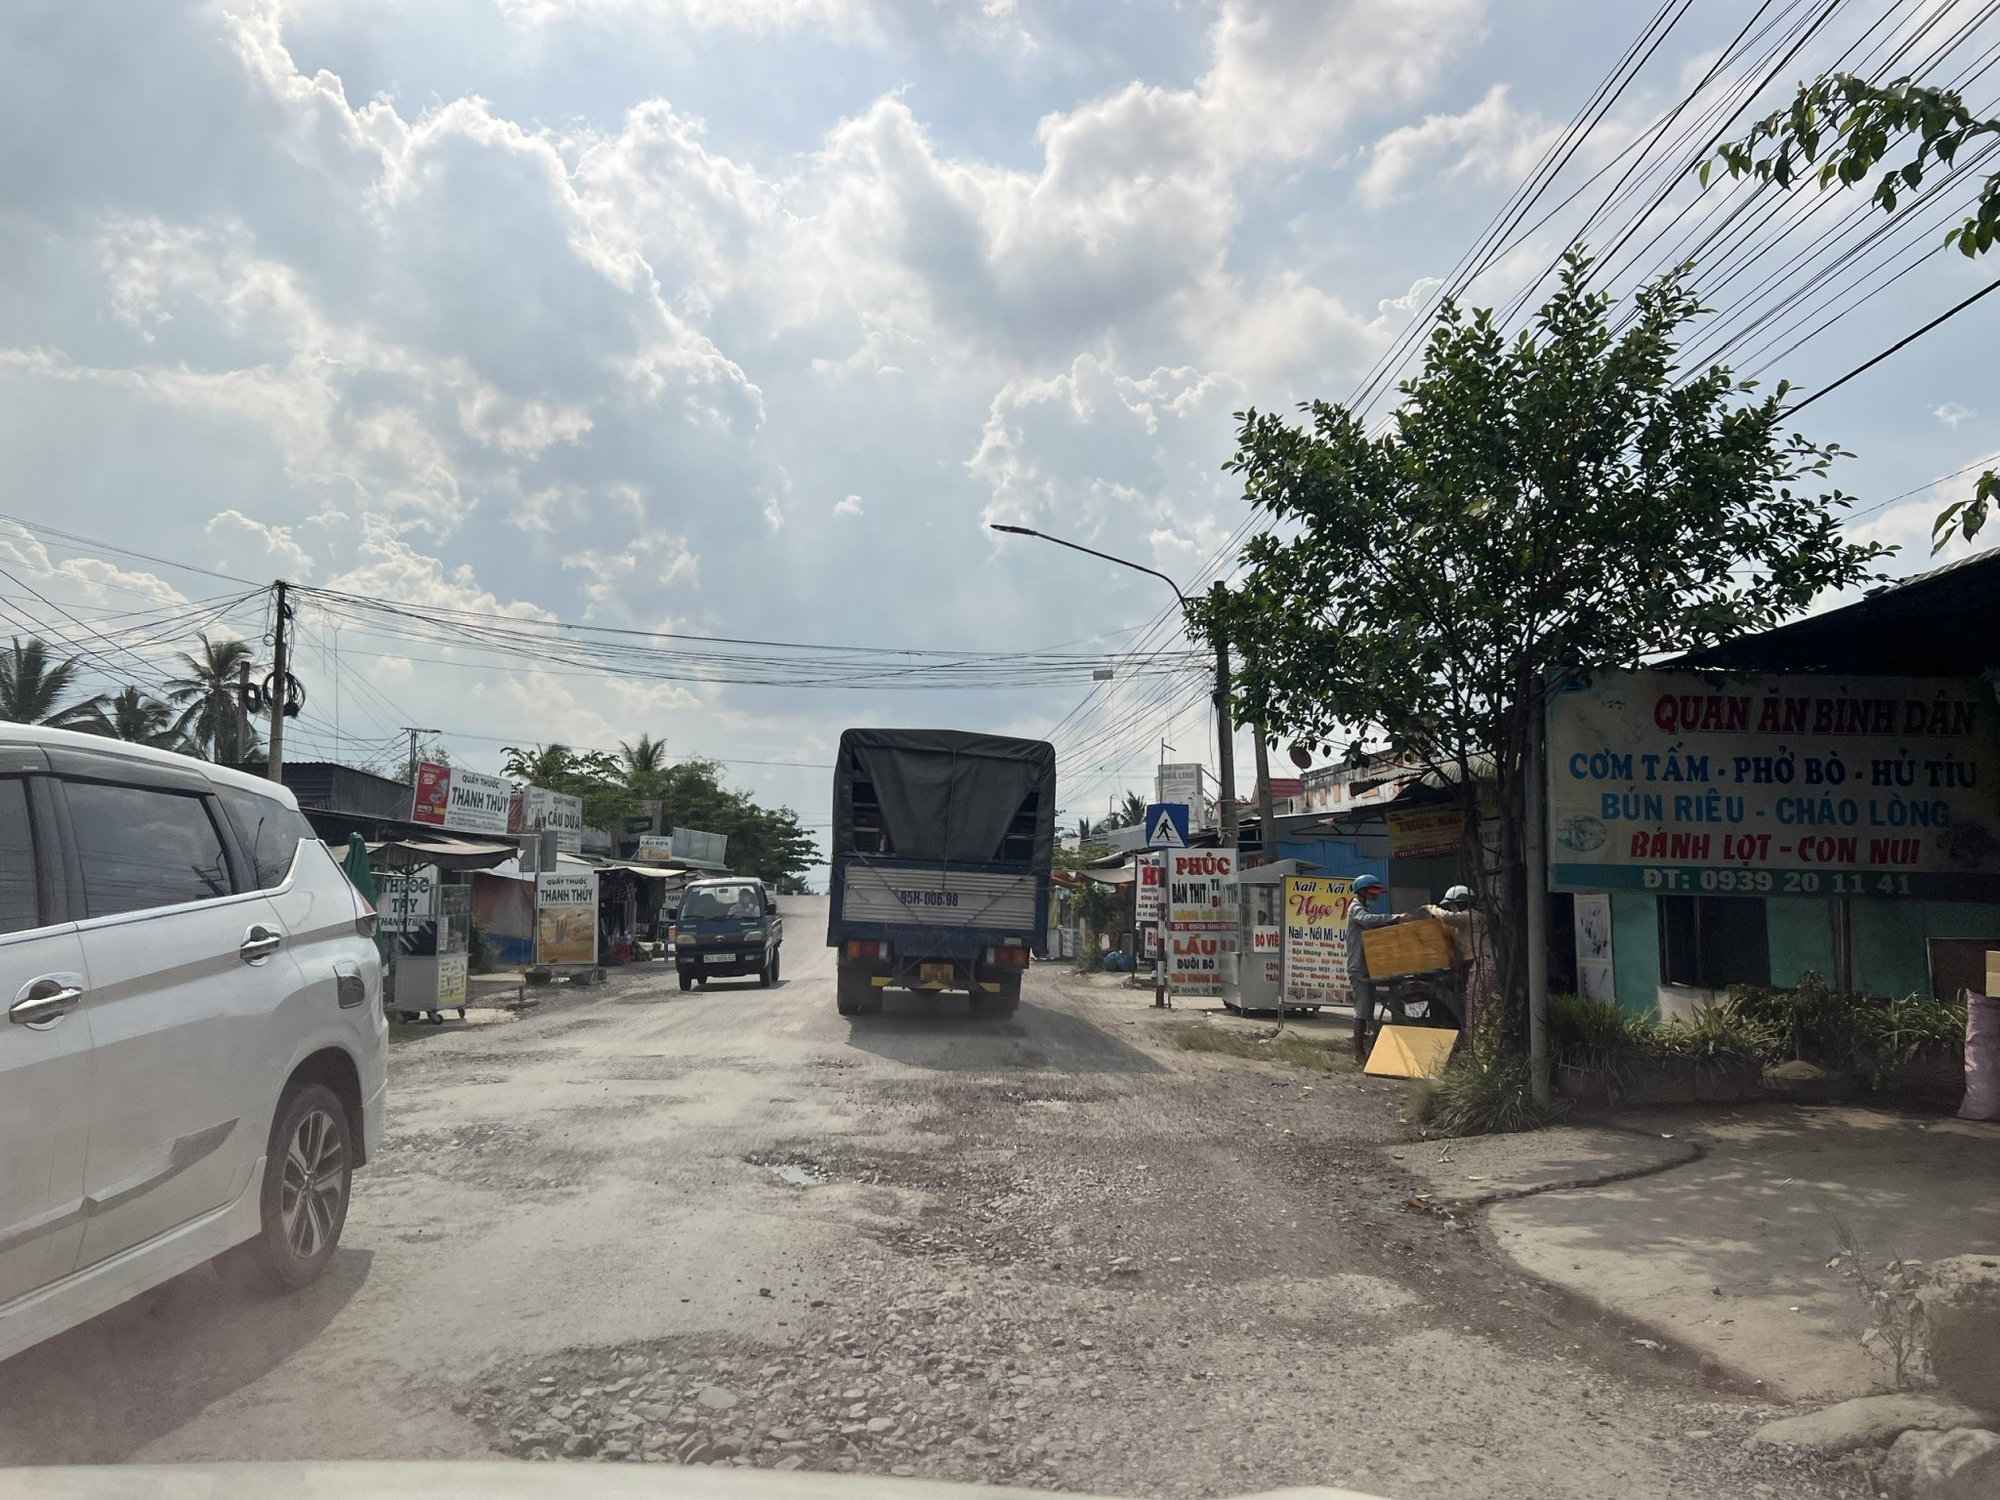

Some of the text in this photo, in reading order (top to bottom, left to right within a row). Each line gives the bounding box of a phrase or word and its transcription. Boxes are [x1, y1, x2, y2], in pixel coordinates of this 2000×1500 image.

[1757, 686, 1808, 735] ĂN
[1812, 686, 1896, 736] BÌNH
[1903, 689, 1977, 737] DÂN
[1569, 742, 1978, 788] CƠM TẤM PHỞ BÒ HỦ TÍU
[451, 786, 485, 808] THANH
[486, 791, 509, 814] THÚY
[1601, 786, 1951, 828] BÚN RIÊU CHÁO LÒNG
[1631, 827, 1921, 866] BÁNH LỌT CON NUI
[1175, 851, 1231, 876] PHÚC
[540, 885, 593, 902] THANH THÚY
[1293, 881, 1317, 892] Nail
[1327, 883, 1345, 893] Nối
[1643, 868, 1911, 894] ĐT: 0939 20 11 41
[1289, 926, 1304, 939] Nail
[1309, 925, 1322, 941] Nối
[1323, 928, 1333, 941] Mi
